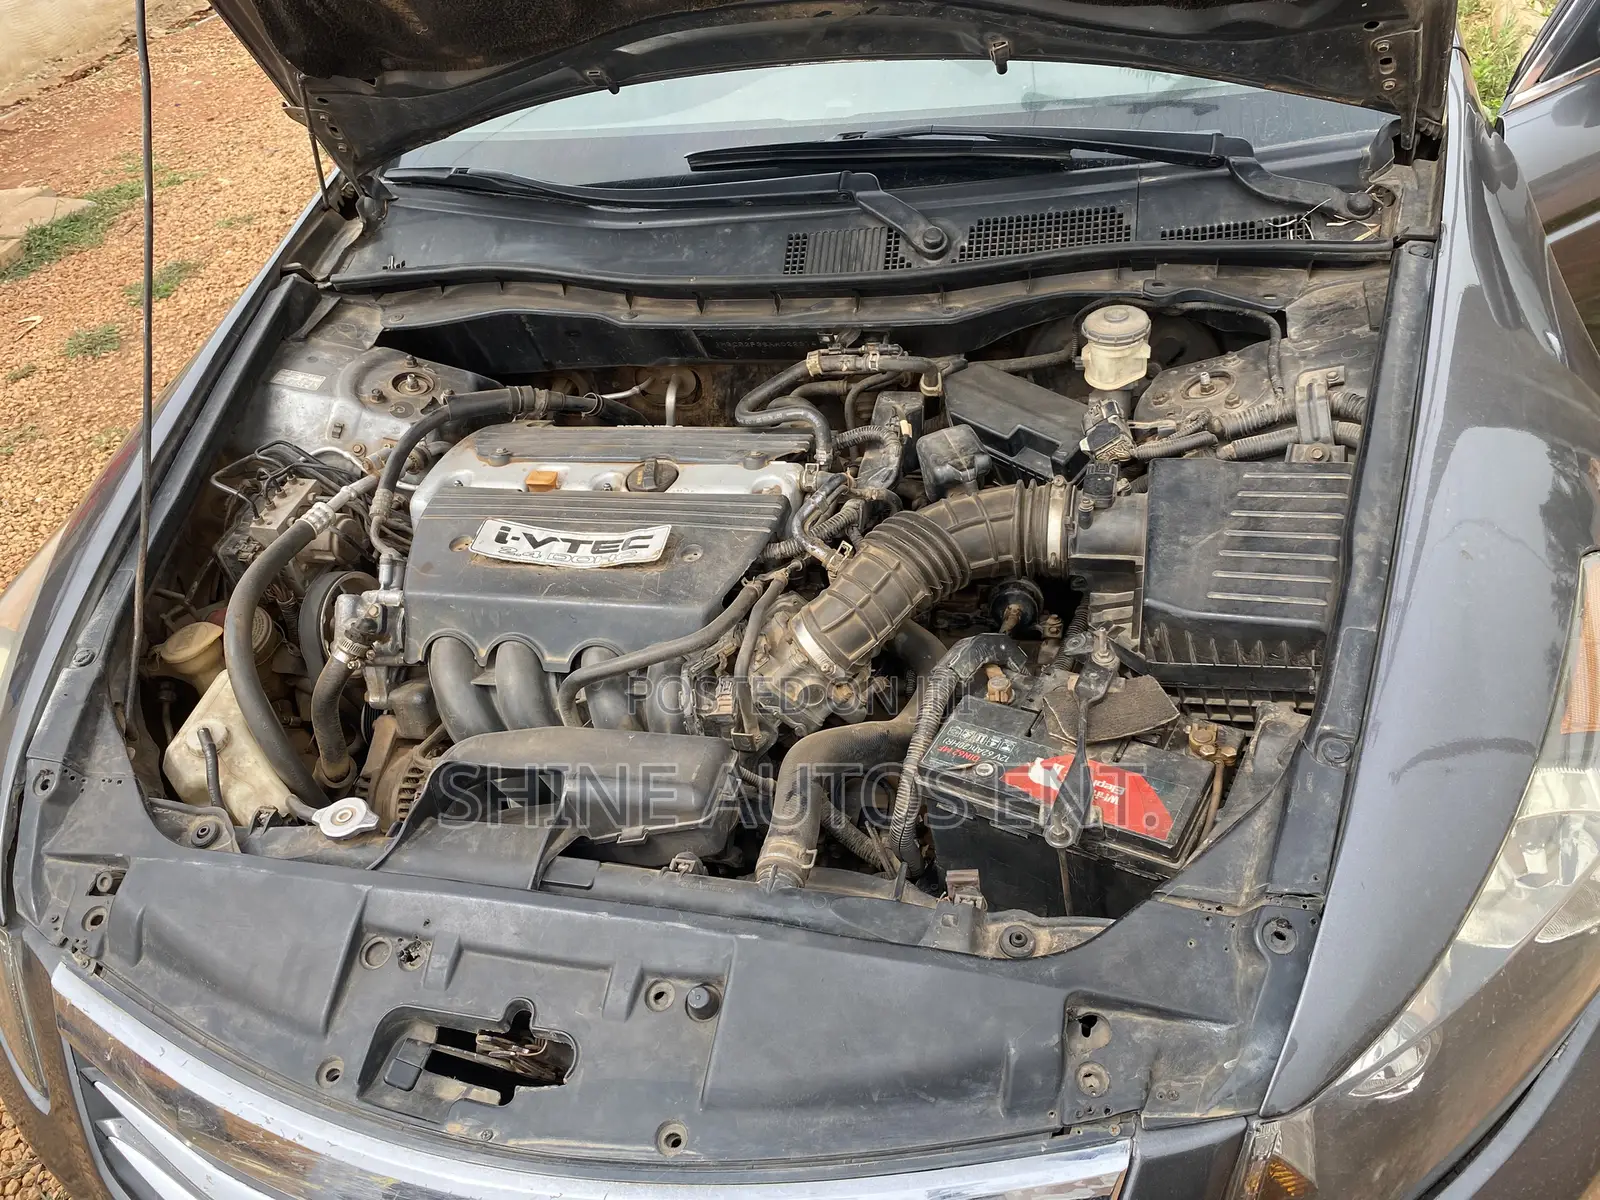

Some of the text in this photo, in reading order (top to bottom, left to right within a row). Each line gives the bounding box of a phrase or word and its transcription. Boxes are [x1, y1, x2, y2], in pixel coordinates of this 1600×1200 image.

[494, 525, 655, 555] i-VTEC
[547, 549, 638, 564] DOHC
[992, 753, 1010, 763] 12V
